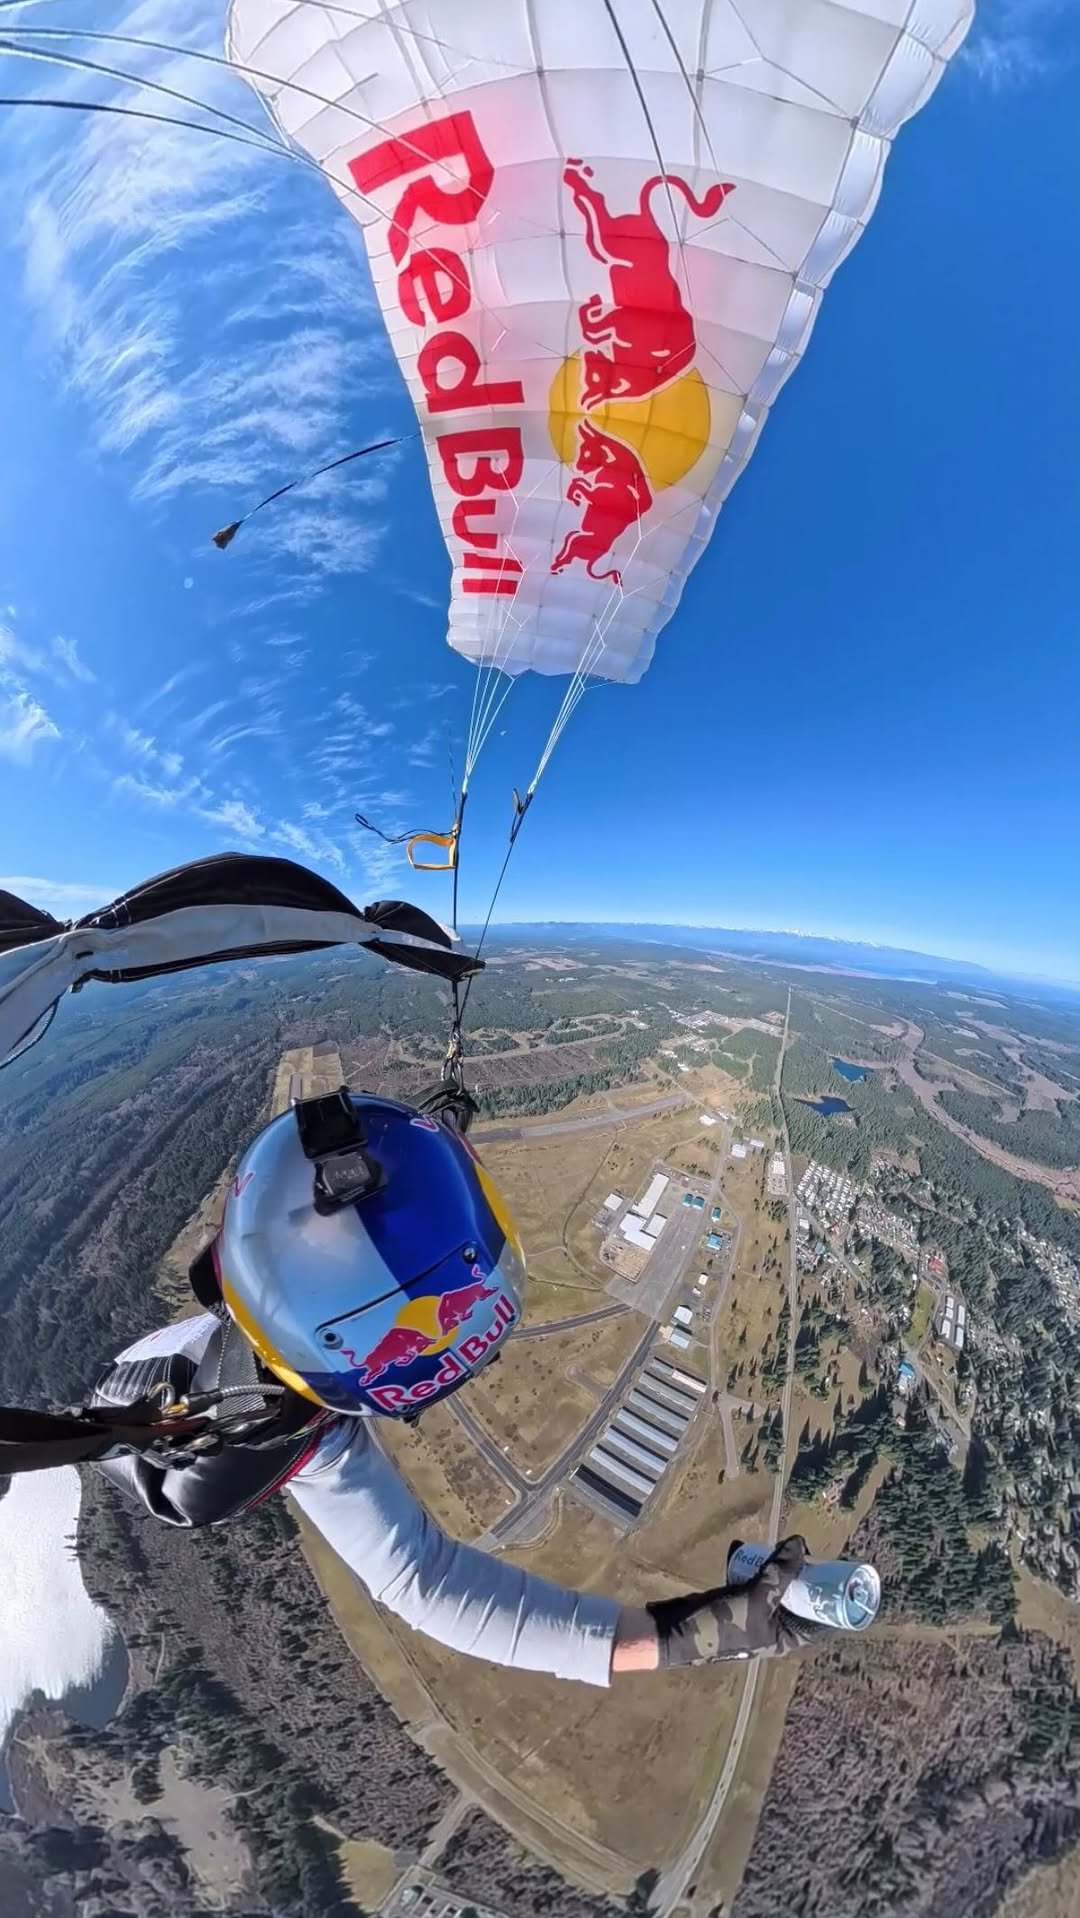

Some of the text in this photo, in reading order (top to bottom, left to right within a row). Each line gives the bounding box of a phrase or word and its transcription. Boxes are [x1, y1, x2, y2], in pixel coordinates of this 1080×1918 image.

[347, 110, 525, 594] Red Bull
[366, 1294, 516, 1412] Red Bull
